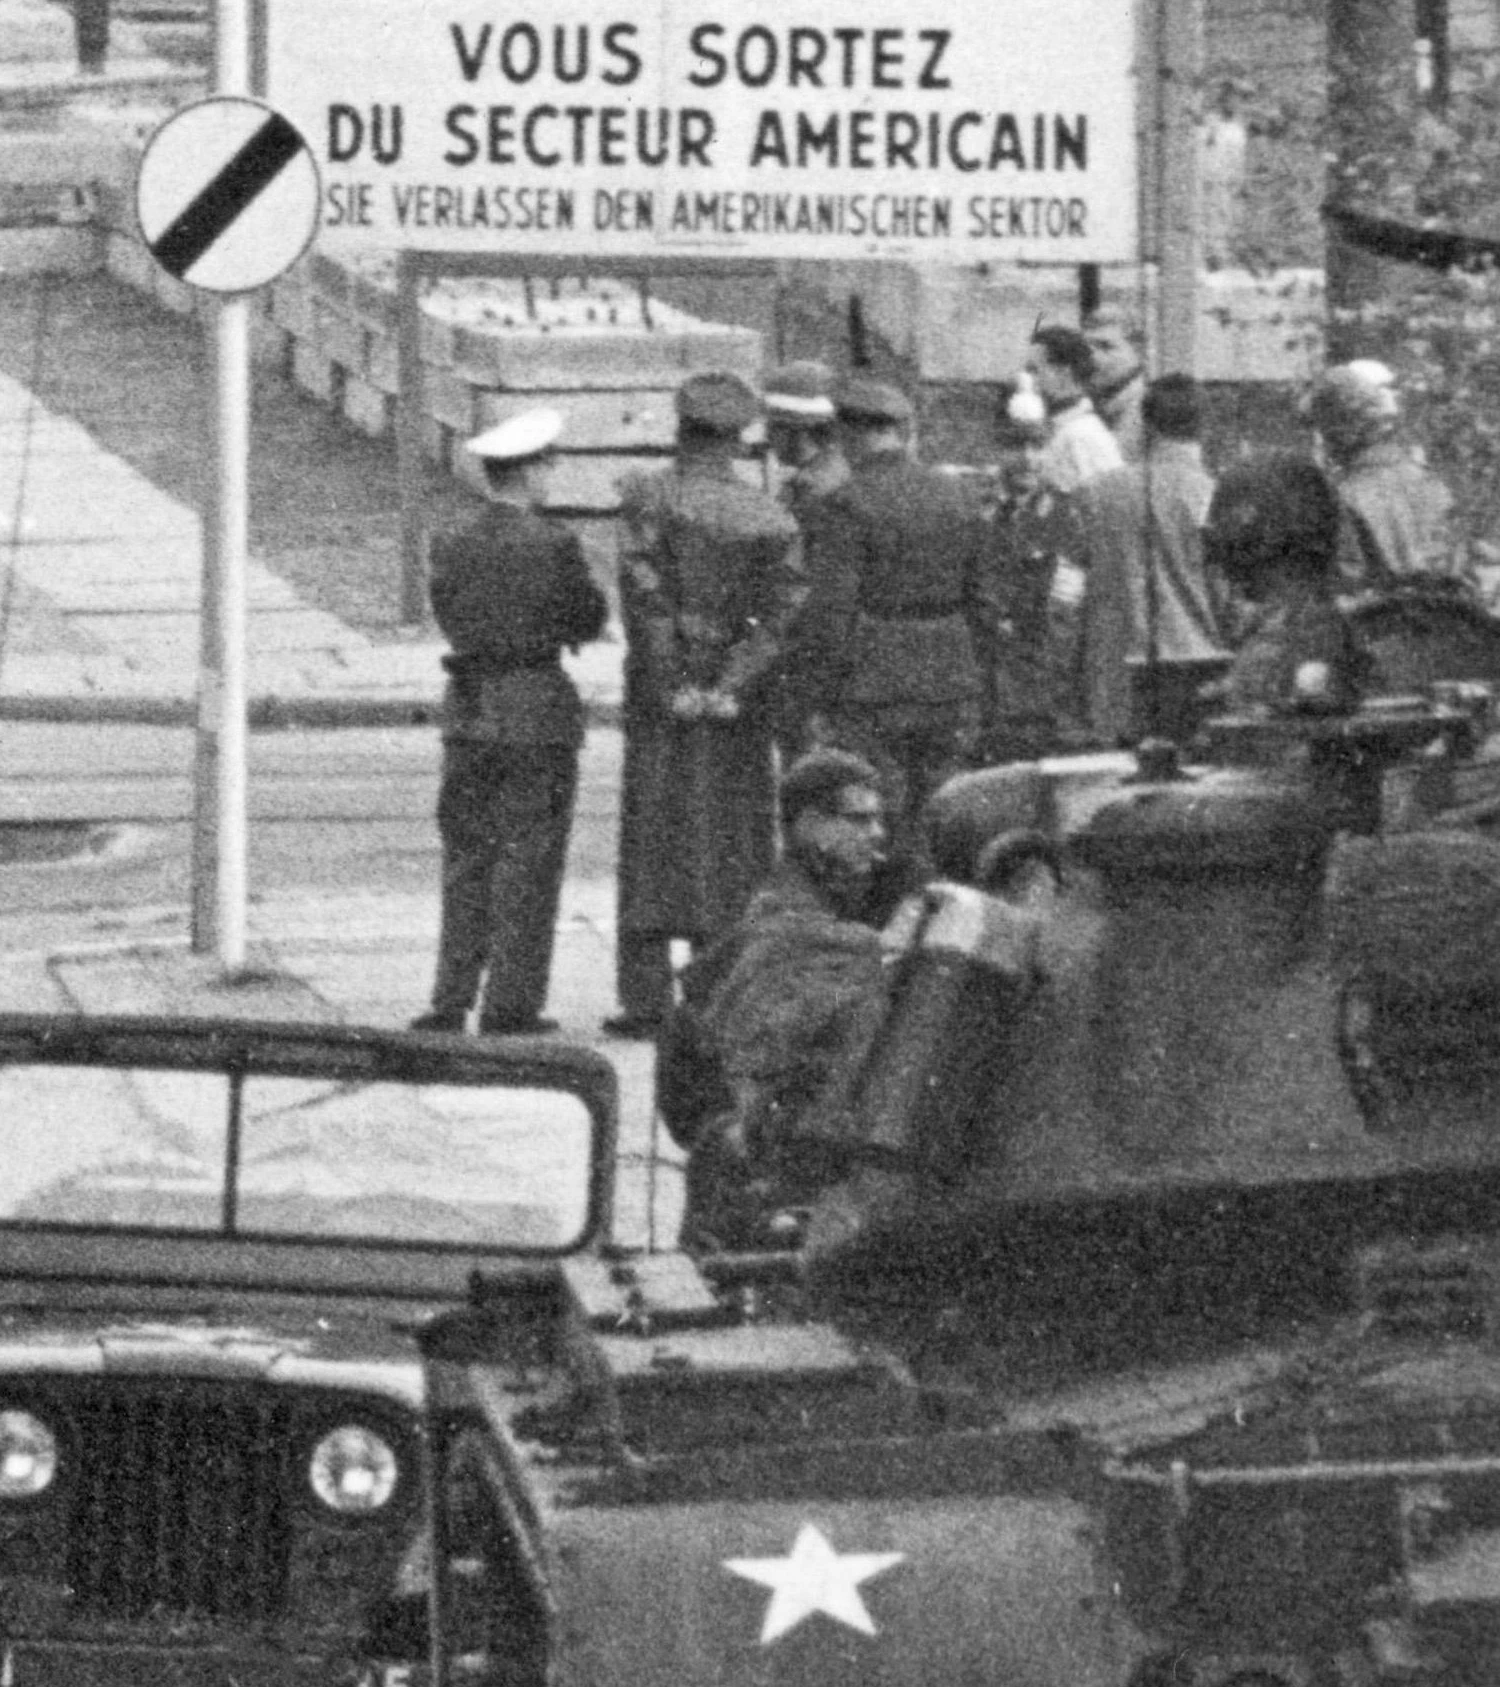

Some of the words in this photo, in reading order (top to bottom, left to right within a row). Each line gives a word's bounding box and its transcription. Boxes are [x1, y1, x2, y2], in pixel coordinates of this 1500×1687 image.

[451, 22, 642, 86] VOUS
[689, 23, 951, 89] SORTEZ
[328, 104, 402, 165] DU
[445, 104, 714, 168] SECTEUR
[751, 110, 1088, 172] AMERICAIN
[326, 184, 373, 229] SIE
[395, 185, 574, 230] VERLASSEN
[594, 189, 654, 231] DEN
[673, 192, 950, 238] AMERIKANISCHEN
[968, 196, 1087, 238] SEKTOR
